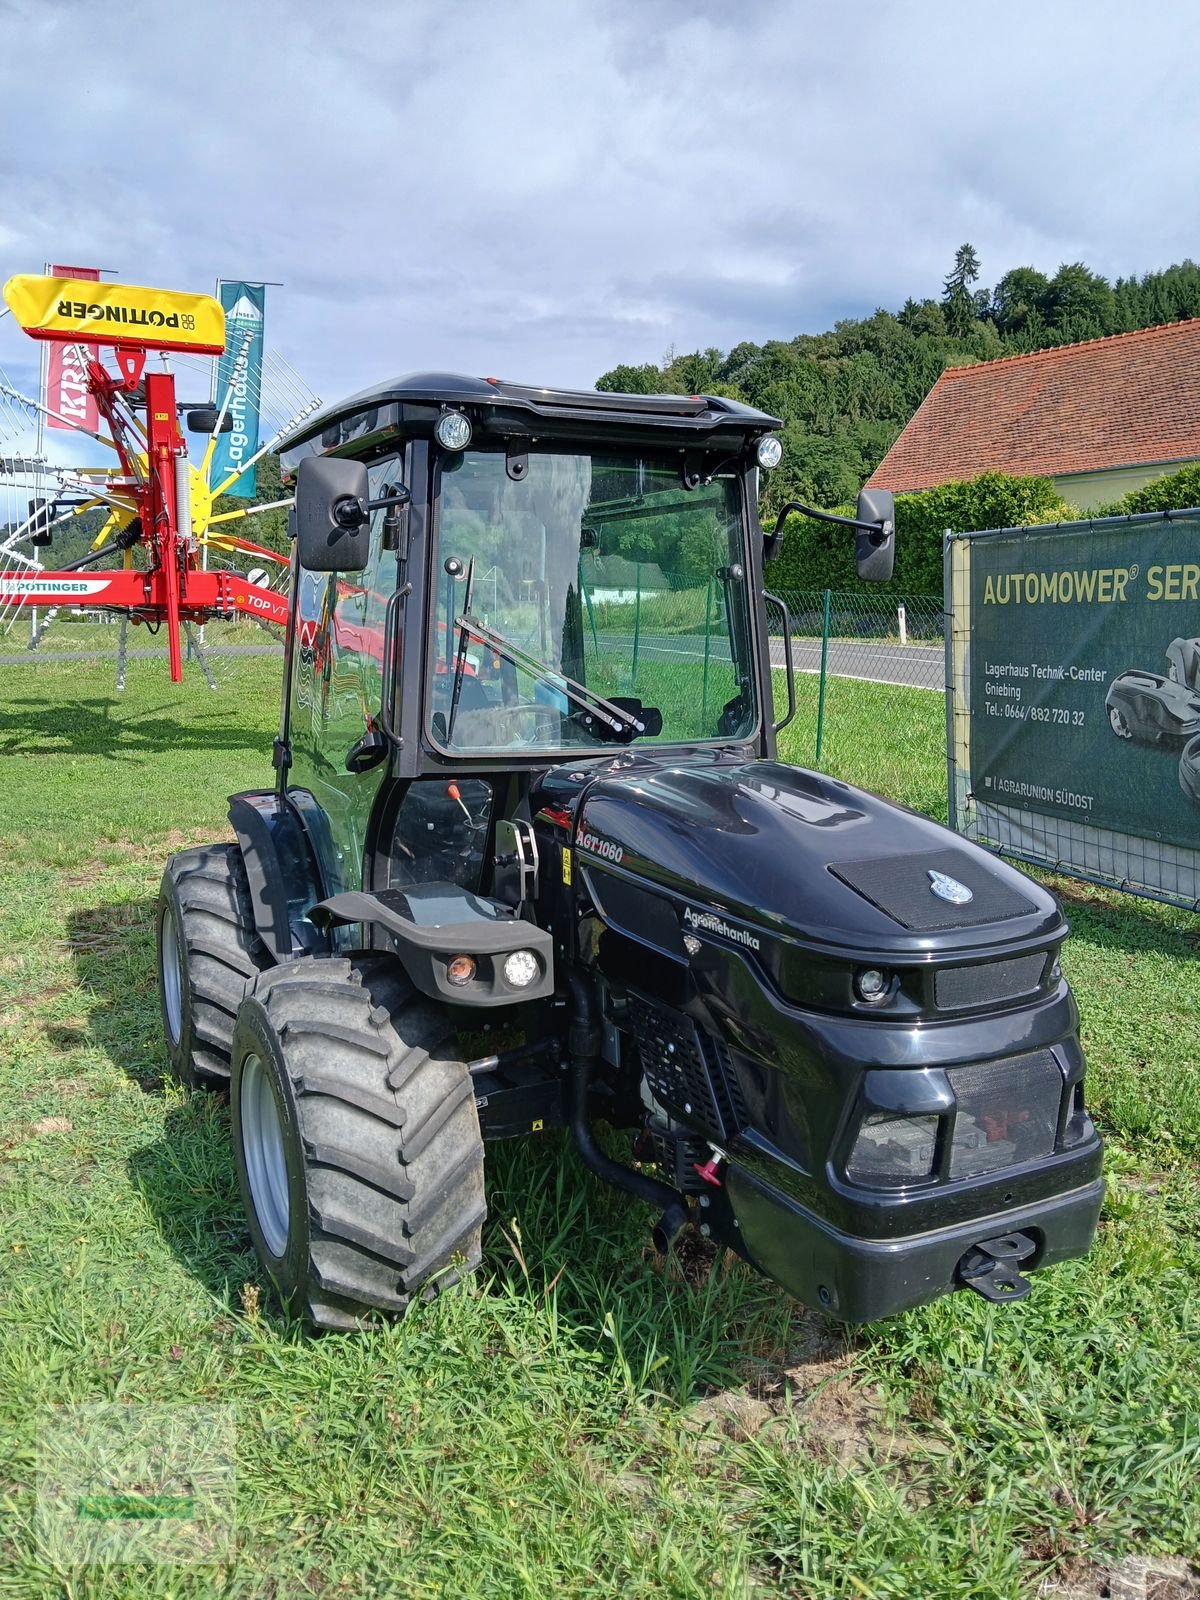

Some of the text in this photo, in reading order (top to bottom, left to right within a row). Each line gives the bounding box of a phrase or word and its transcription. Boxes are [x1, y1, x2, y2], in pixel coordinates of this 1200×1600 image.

[247, 594, 287, 617] TOP VT
[985, 661, 1107, 682] Lagerhaus Technik-Center
[985, 682, 1021, 701] Gniebing
[985, 701, 1085, 726] Tel.: 0664/882 720 32
[998, 778, 1094, 811] AGRARUNION SÜDOST
[684, 906, 760, 951] Agromehanika
